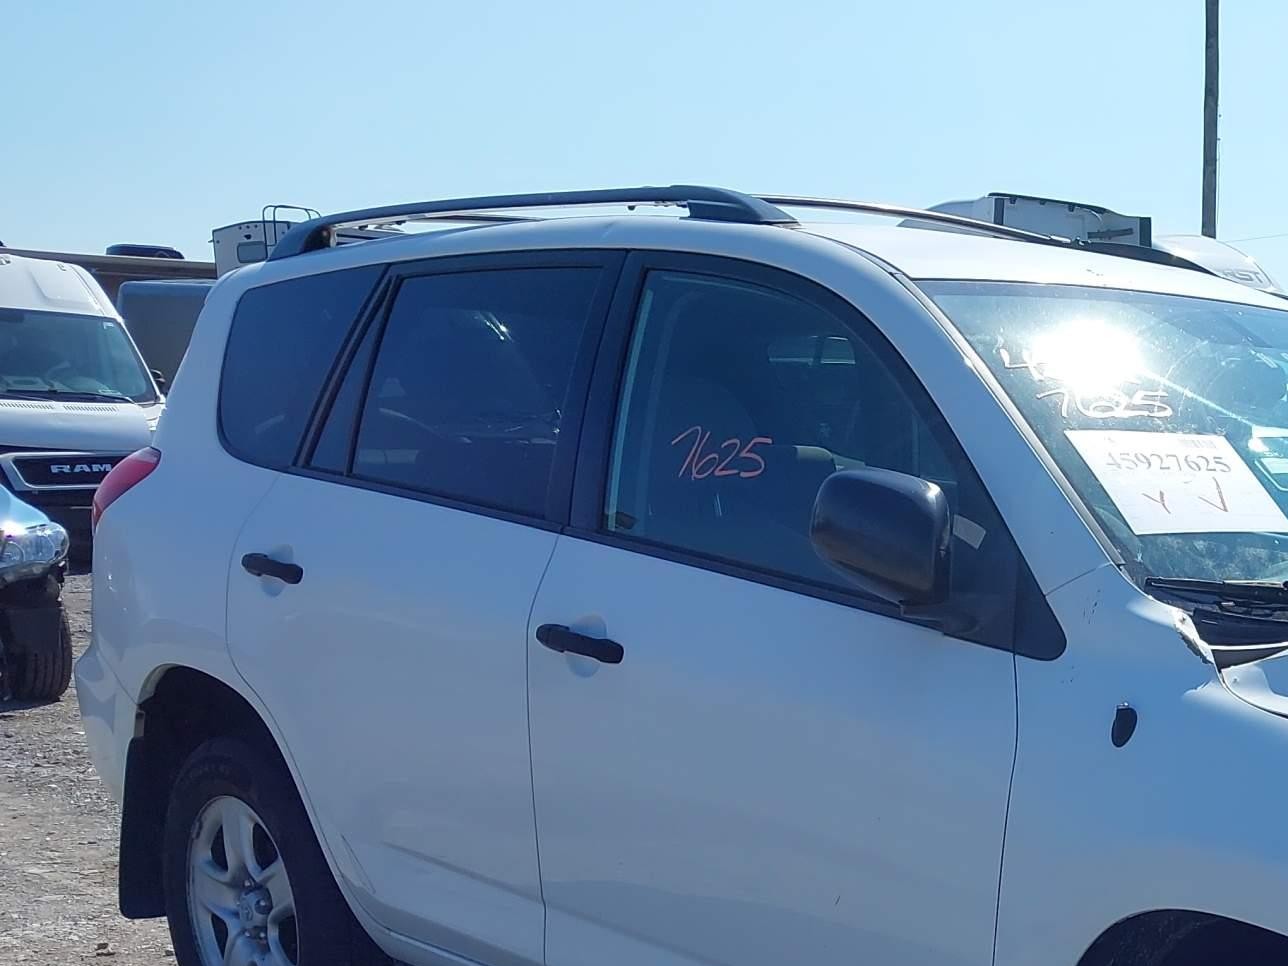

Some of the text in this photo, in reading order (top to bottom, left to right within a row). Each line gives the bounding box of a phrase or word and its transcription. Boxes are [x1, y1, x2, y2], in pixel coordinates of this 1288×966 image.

[672, 425, 772, 480] 7625
[1106, 452, 1232, 473] 45927625
[50, 463, 113, 473] RAM
